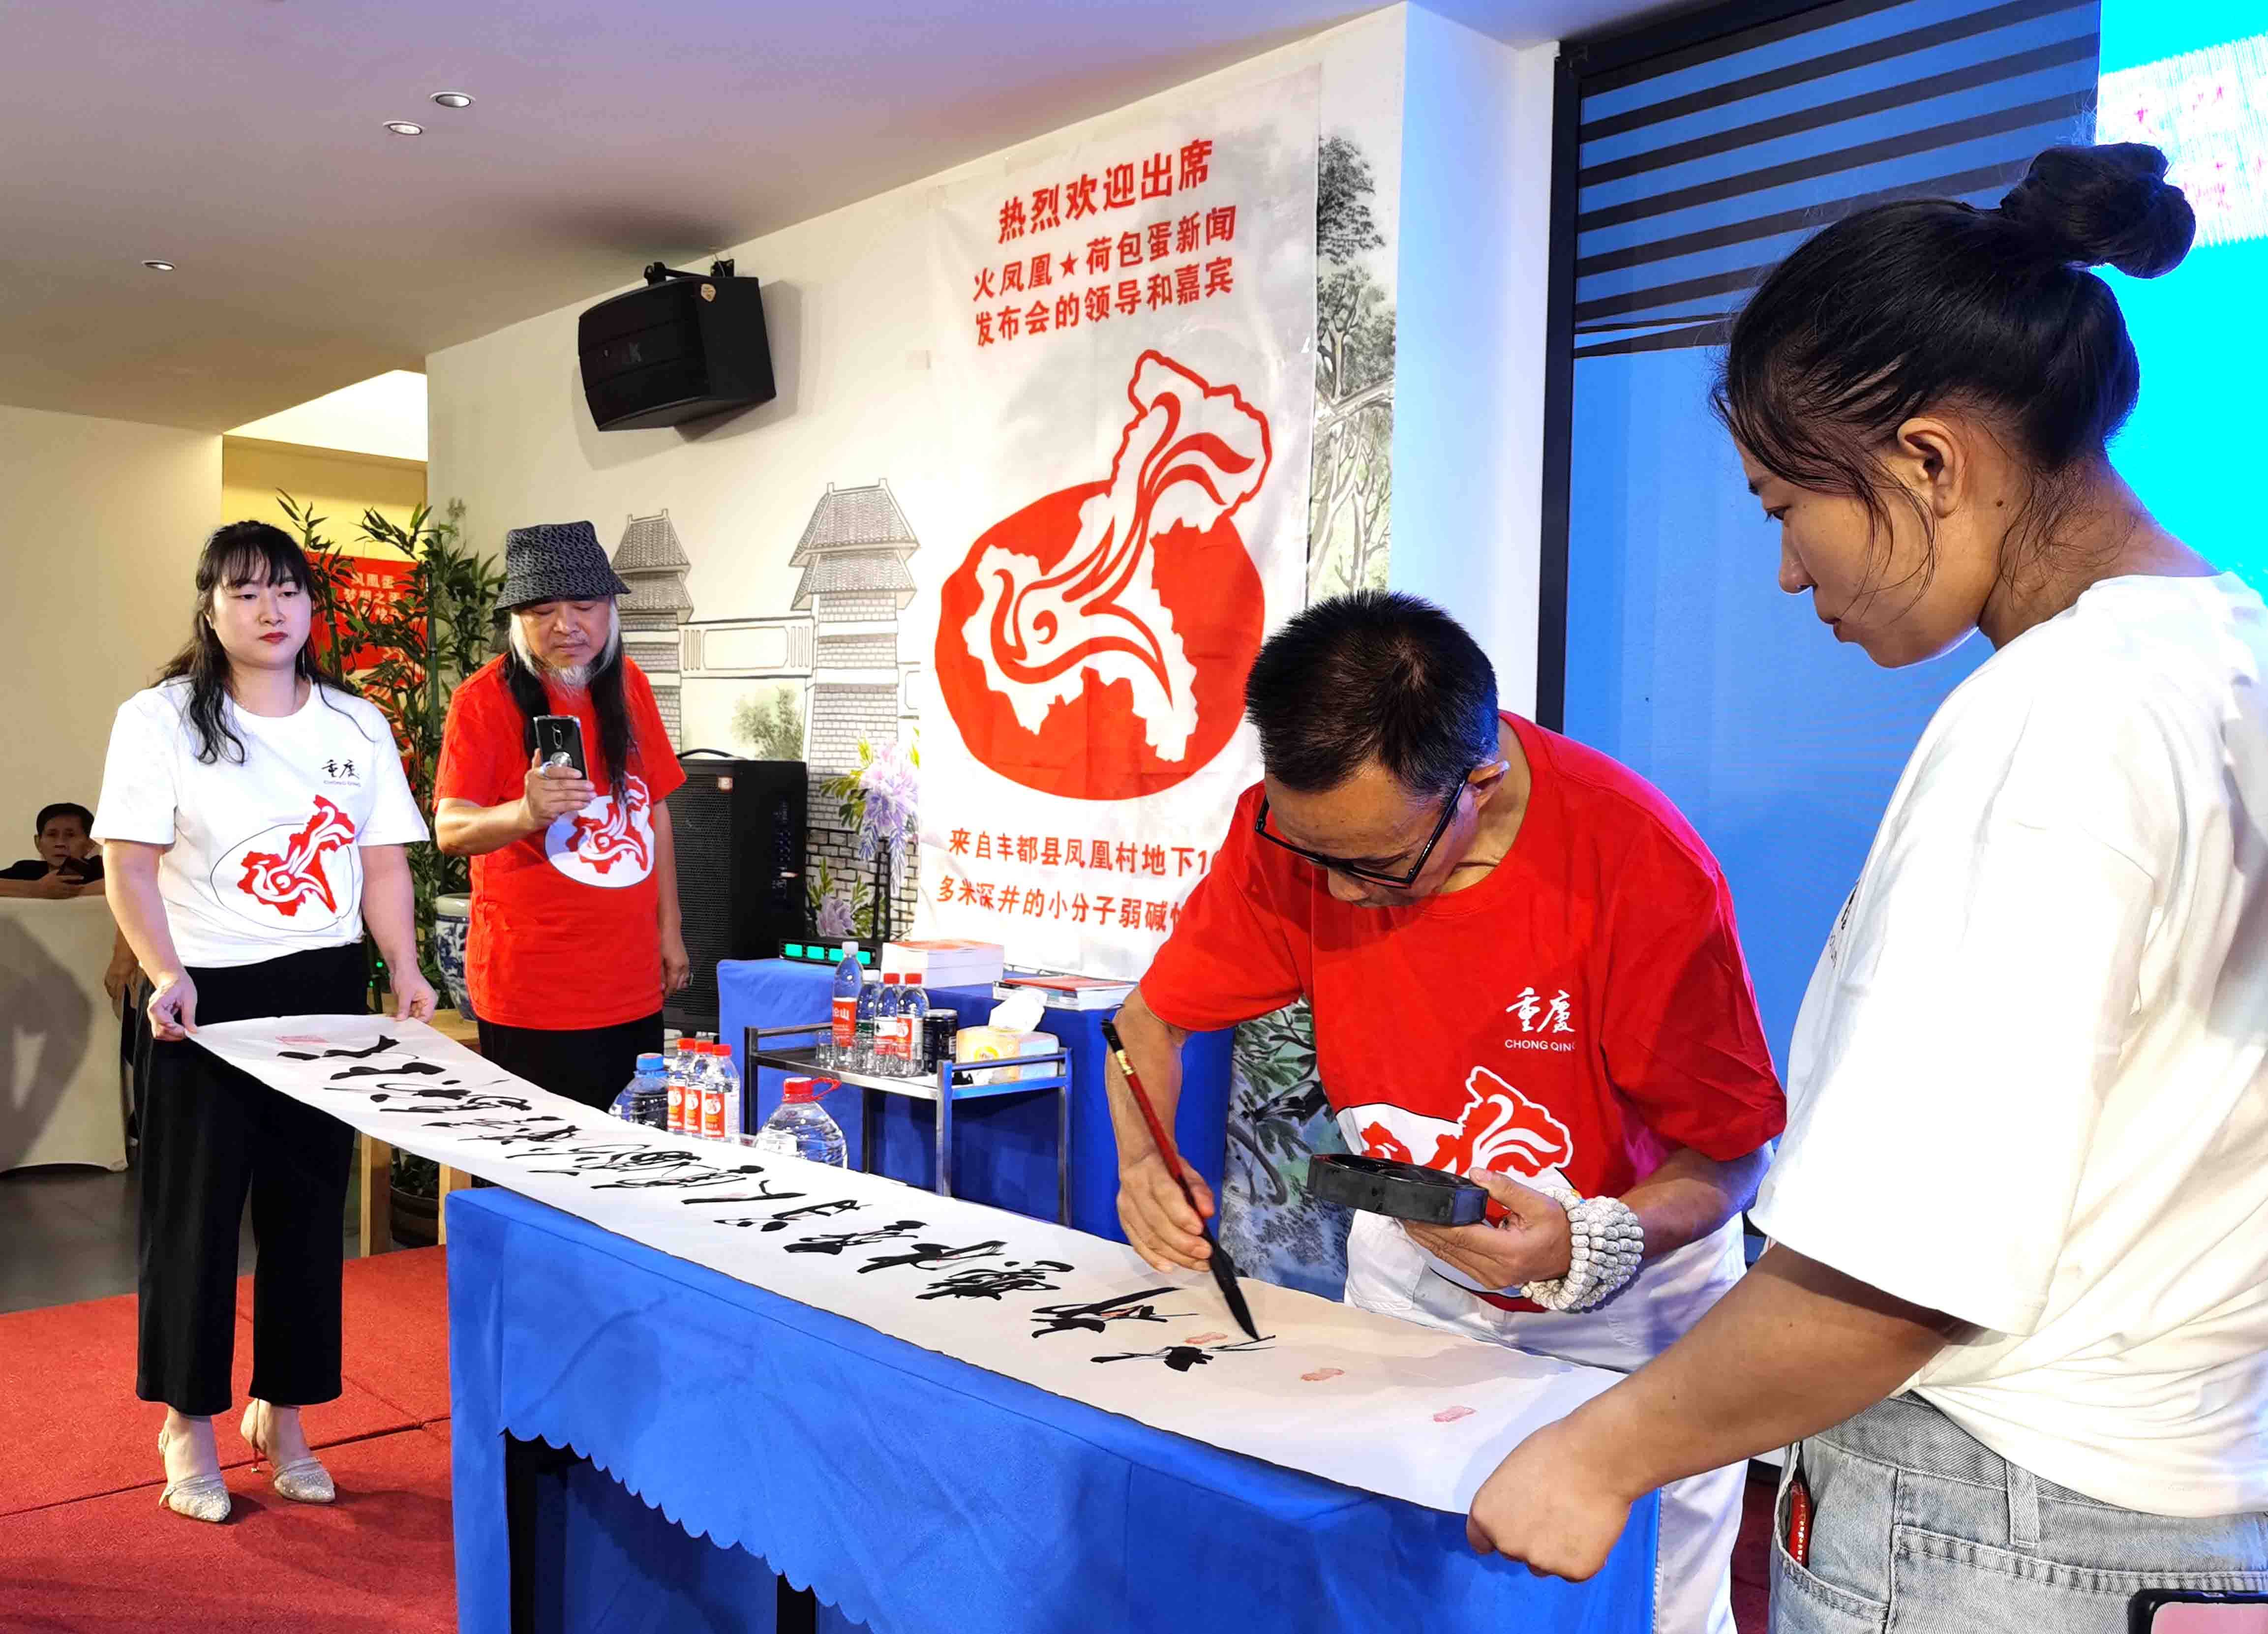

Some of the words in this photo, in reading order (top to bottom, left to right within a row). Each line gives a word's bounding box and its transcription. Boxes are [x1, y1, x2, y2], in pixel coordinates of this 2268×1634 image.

[998, 138, 1213, 244] 热烈欢迎出席
[975, 256, 1234, 347] 发布会的领导和嘉宾
[1505, 1039, 1548, 1050] CHONG
